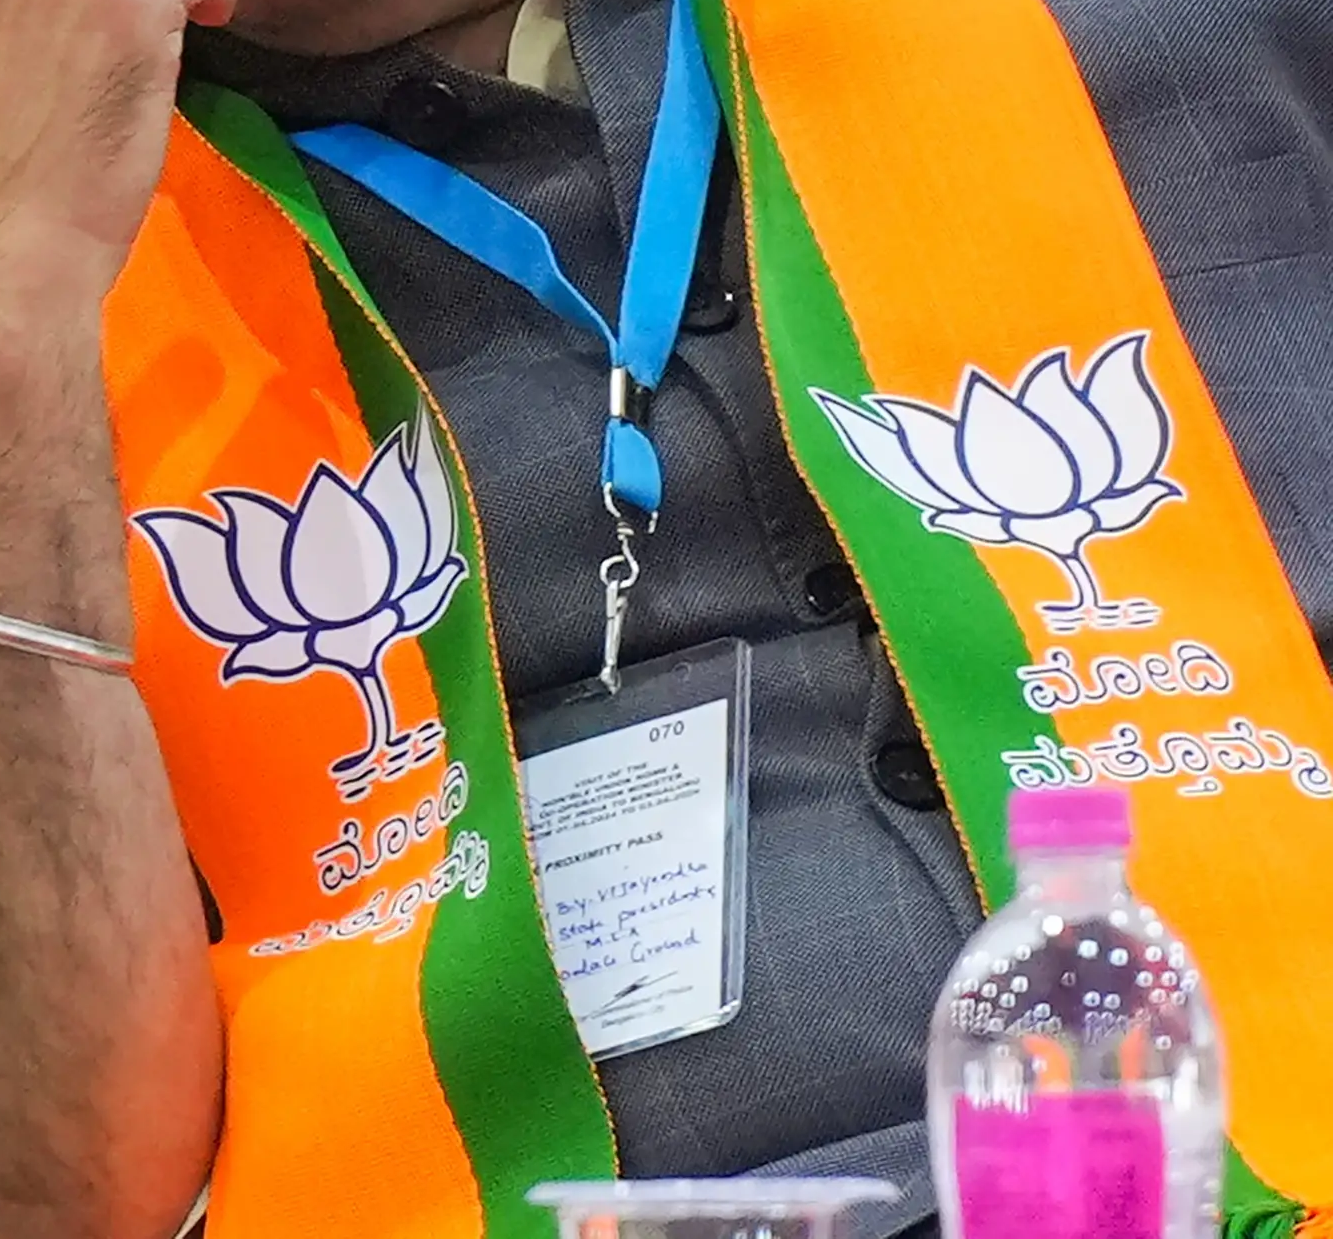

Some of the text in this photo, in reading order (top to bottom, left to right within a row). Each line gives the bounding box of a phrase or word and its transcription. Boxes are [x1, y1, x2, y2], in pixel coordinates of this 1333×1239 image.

[1020, 643, 1232, 711] ಮೋದಿ
[649, 720, 685, 743] 070
[1003, 718, 1333, 800] ಮತ್ತೊಮ್ಮೆ
[315, 762, 468, 893] ಮೋದಿ
[612, 798, 628, 808] TO
[545, 831, 664, 872] PROXIMITY PASS
